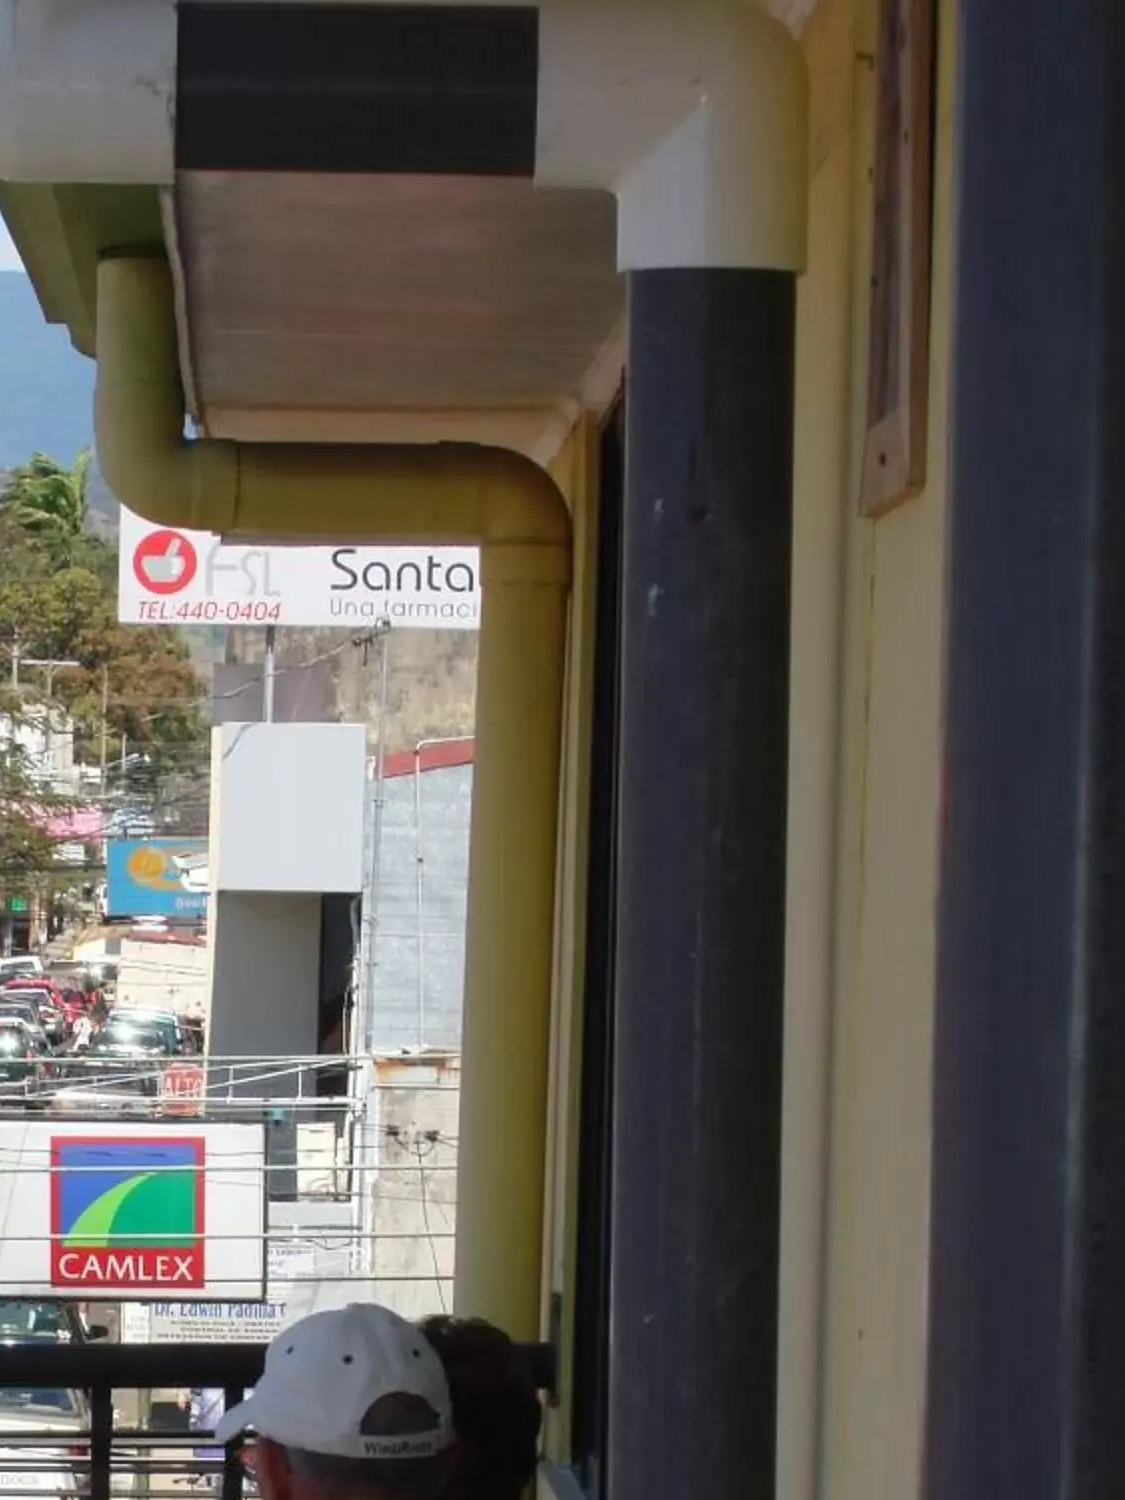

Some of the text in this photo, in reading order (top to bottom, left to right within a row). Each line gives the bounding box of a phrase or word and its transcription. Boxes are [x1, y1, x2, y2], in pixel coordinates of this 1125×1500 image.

[330, 548, 475, 592] Santa
[330, 598, 375, 617] Una
[58, 1252, 194, 1281] CAMLEX
